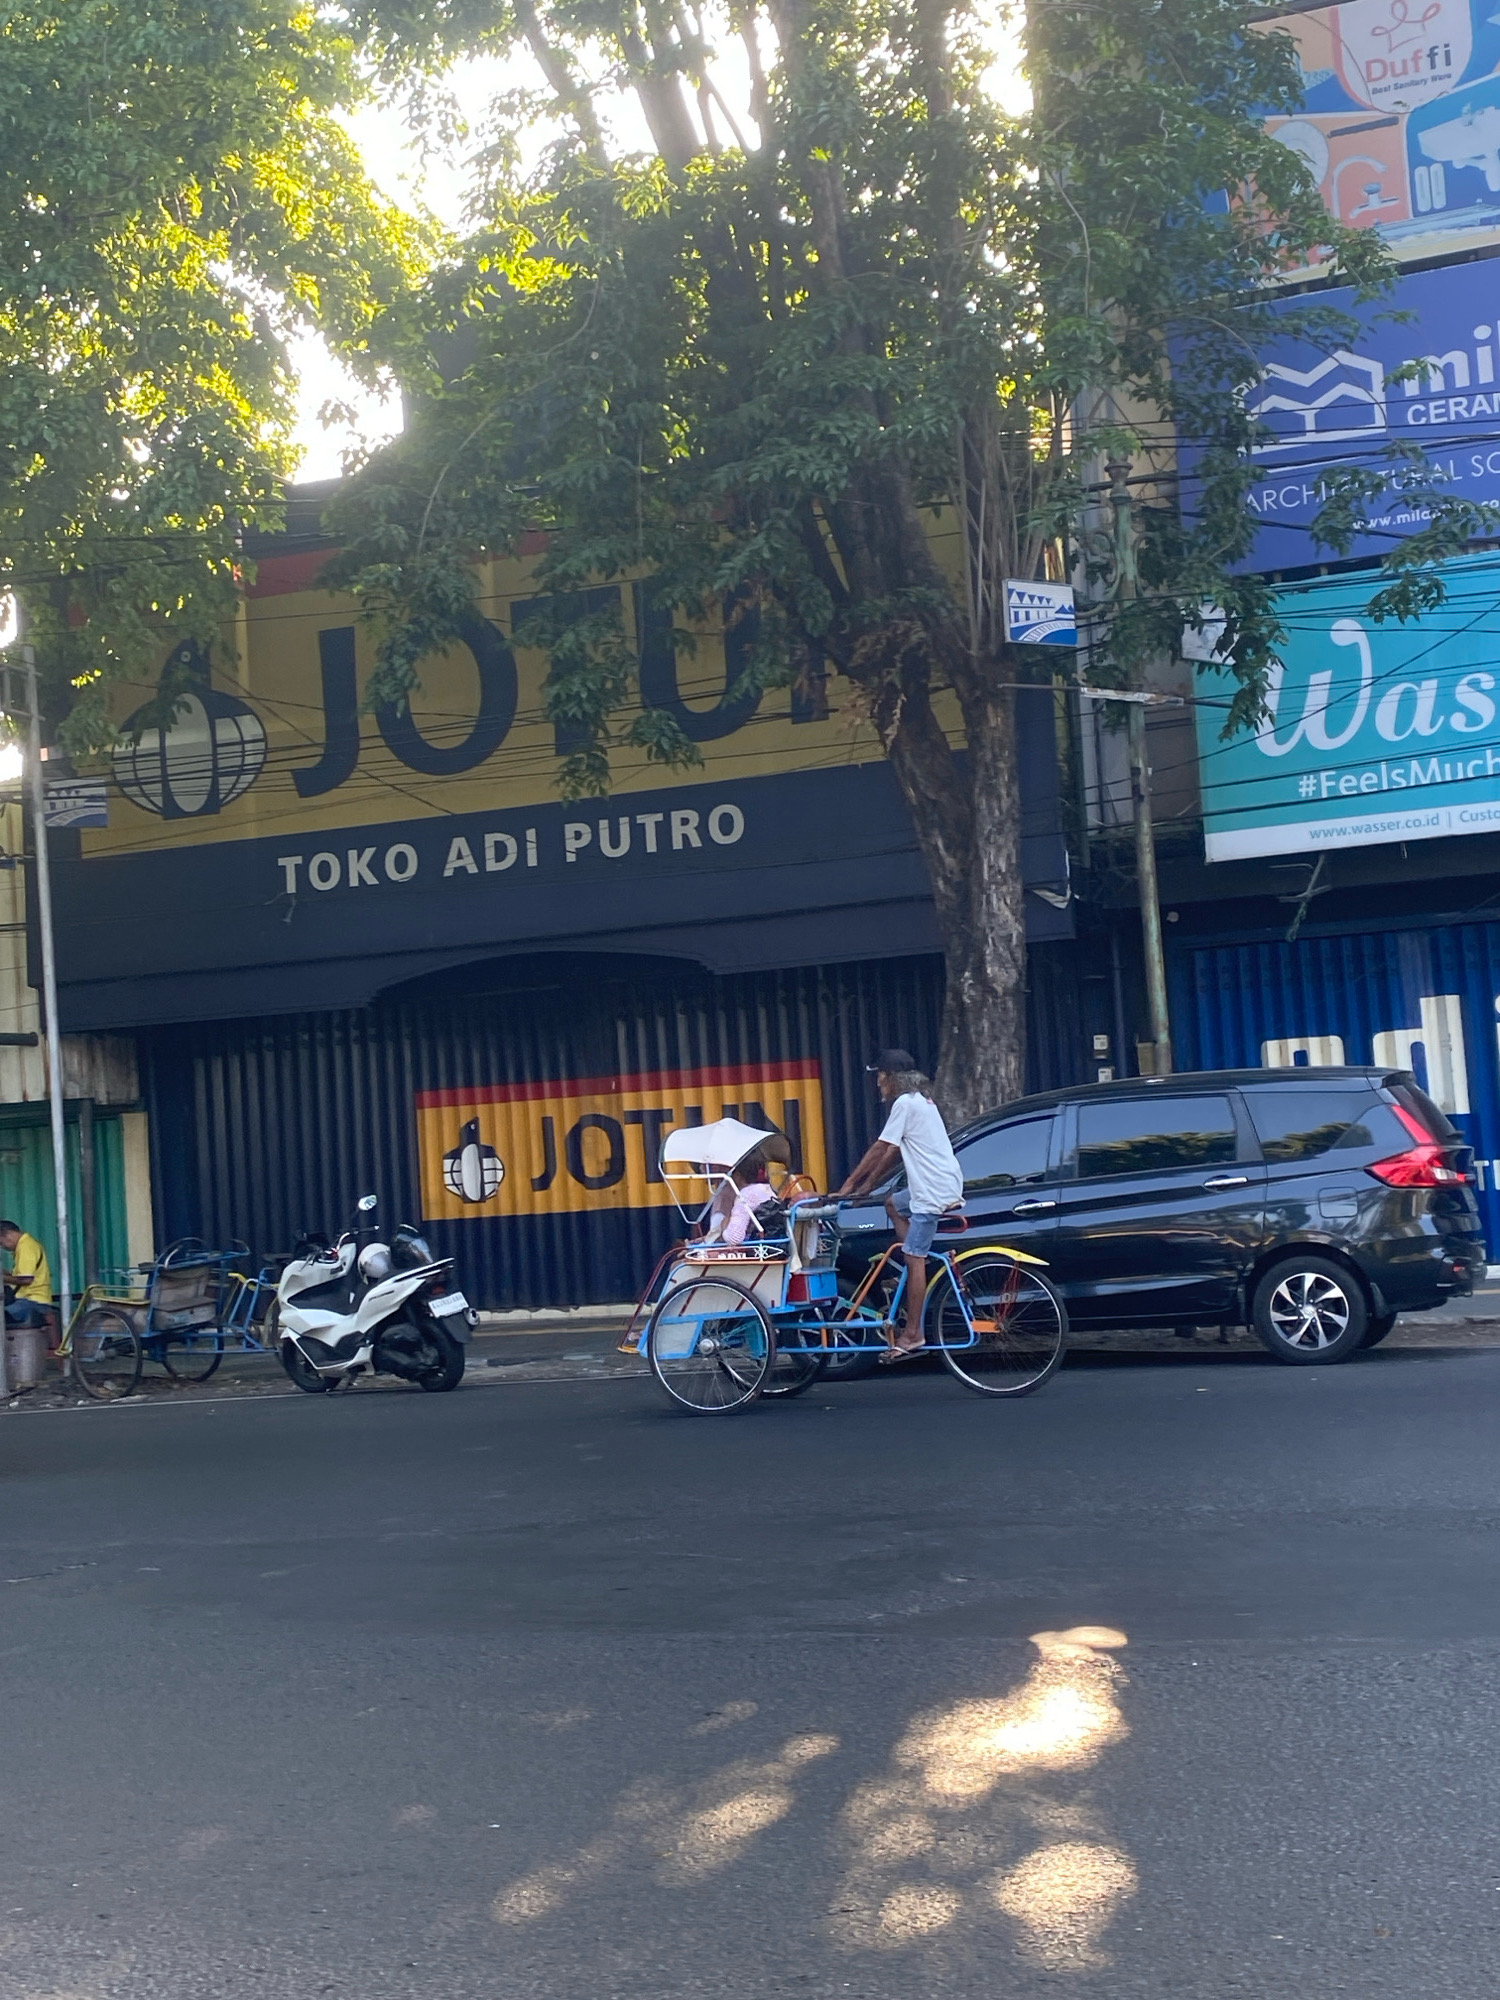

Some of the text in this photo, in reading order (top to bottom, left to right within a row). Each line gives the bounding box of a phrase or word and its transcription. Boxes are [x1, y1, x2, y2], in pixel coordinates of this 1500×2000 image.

[1365, 43, 1452, 83] Duffi
[1372, 73, 1452, 95] Best Sanitary Ware
[1402, 320, 1500, 397] mi
[291, 576, 829, 798] JOTU
[1255, 618, 1496, 757] Was
[1298, 749, 1500, 799] #FeelsMuch
[278, 804, 745, 894] TOKO ADI PUTRO
[1309, 813, 1440, 840] www.wasser.co.id
